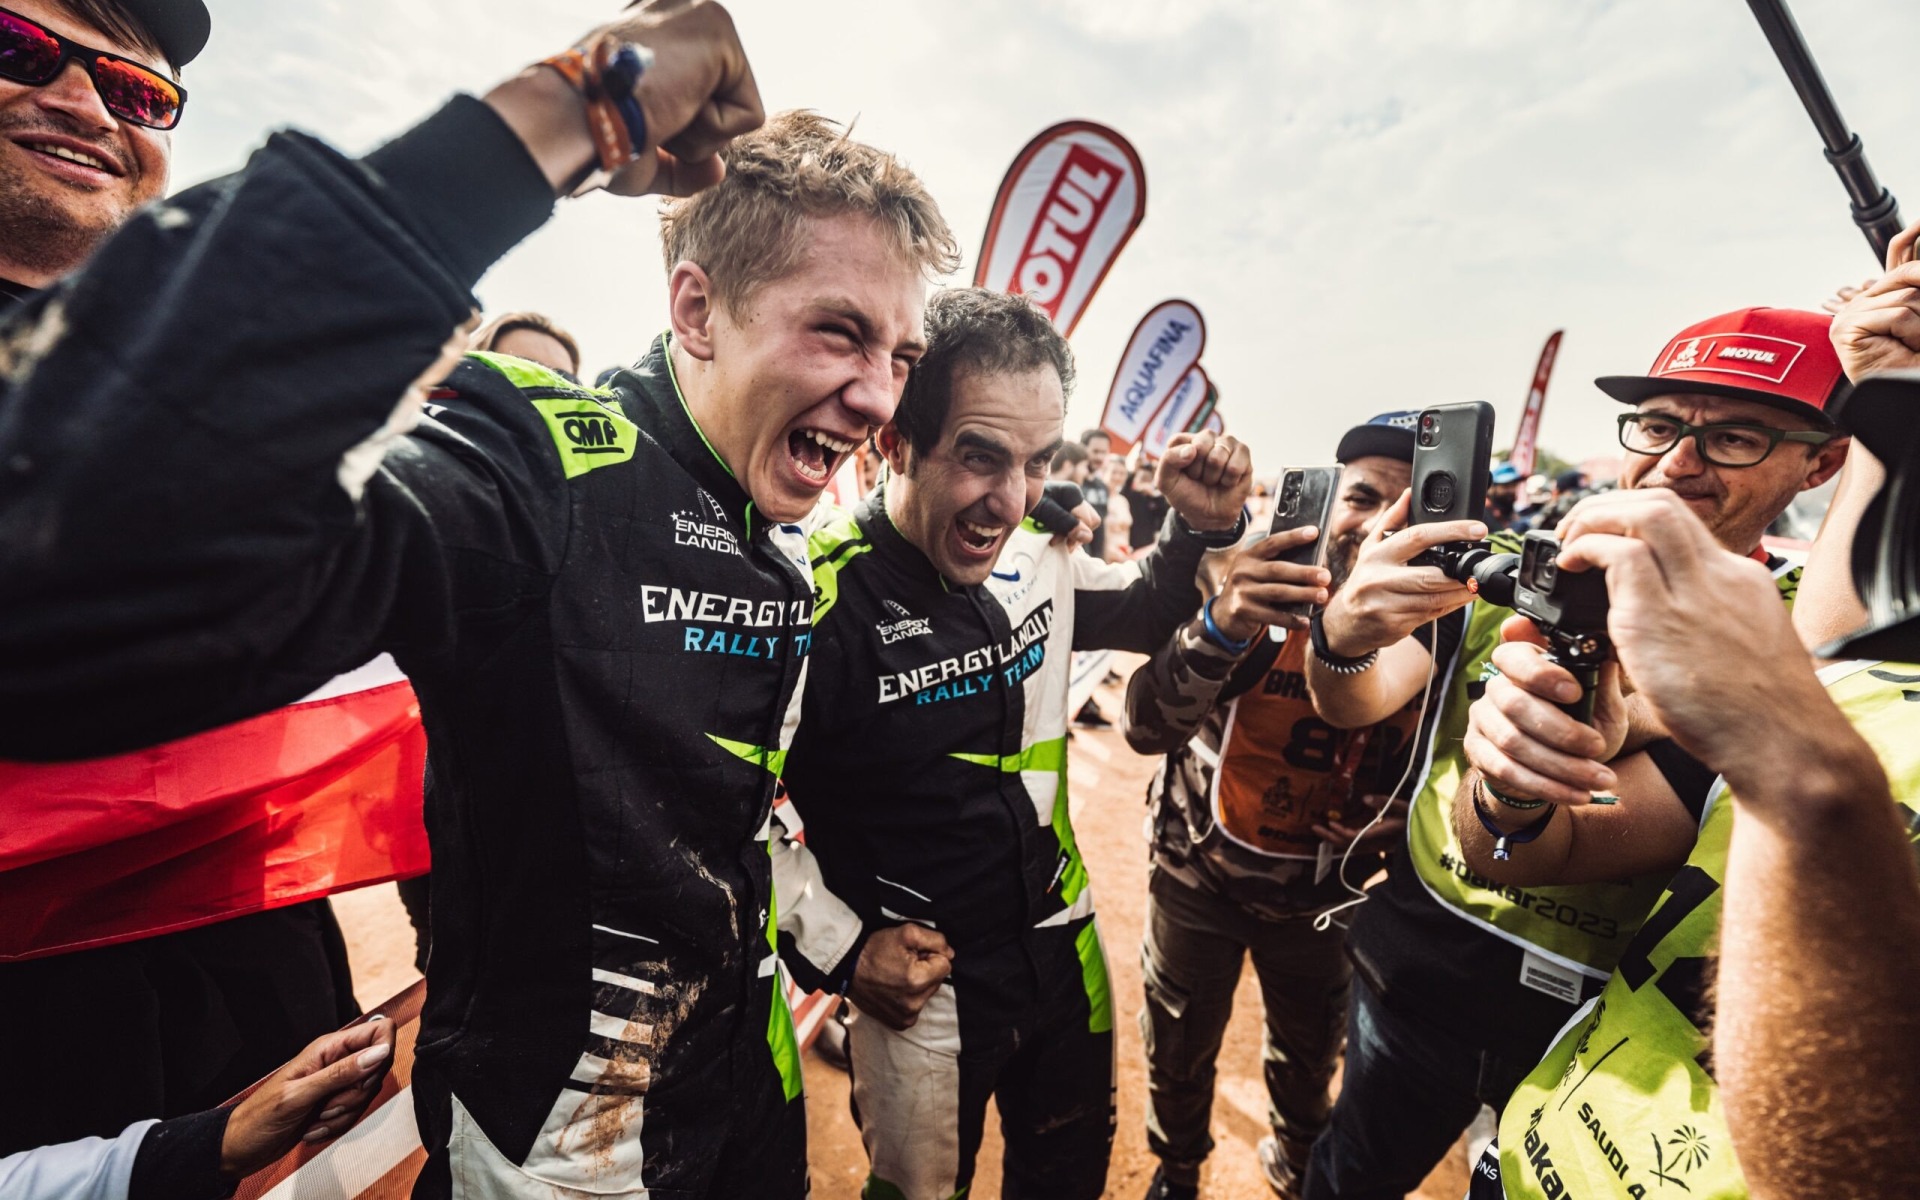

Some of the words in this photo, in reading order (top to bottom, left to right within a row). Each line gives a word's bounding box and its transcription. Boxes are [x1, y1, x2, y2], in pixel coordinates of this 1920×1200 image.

[1019, 160, 1114, 307] OTUL
[1119, 318, 1194, 423] AQUAFINA
[1717, 346, 1776, 363] MOTUL
[563, 417, 618, 447] OMP
[684, 626, 780, 660] RALLY
[915, 673, 993, 705] RALLY
[1003, 642, 1044, 688] TEAM
[1439, 852, 1619, 940] #Dakar2023
[1577, 1101, 1630, 1181] SAUDI
